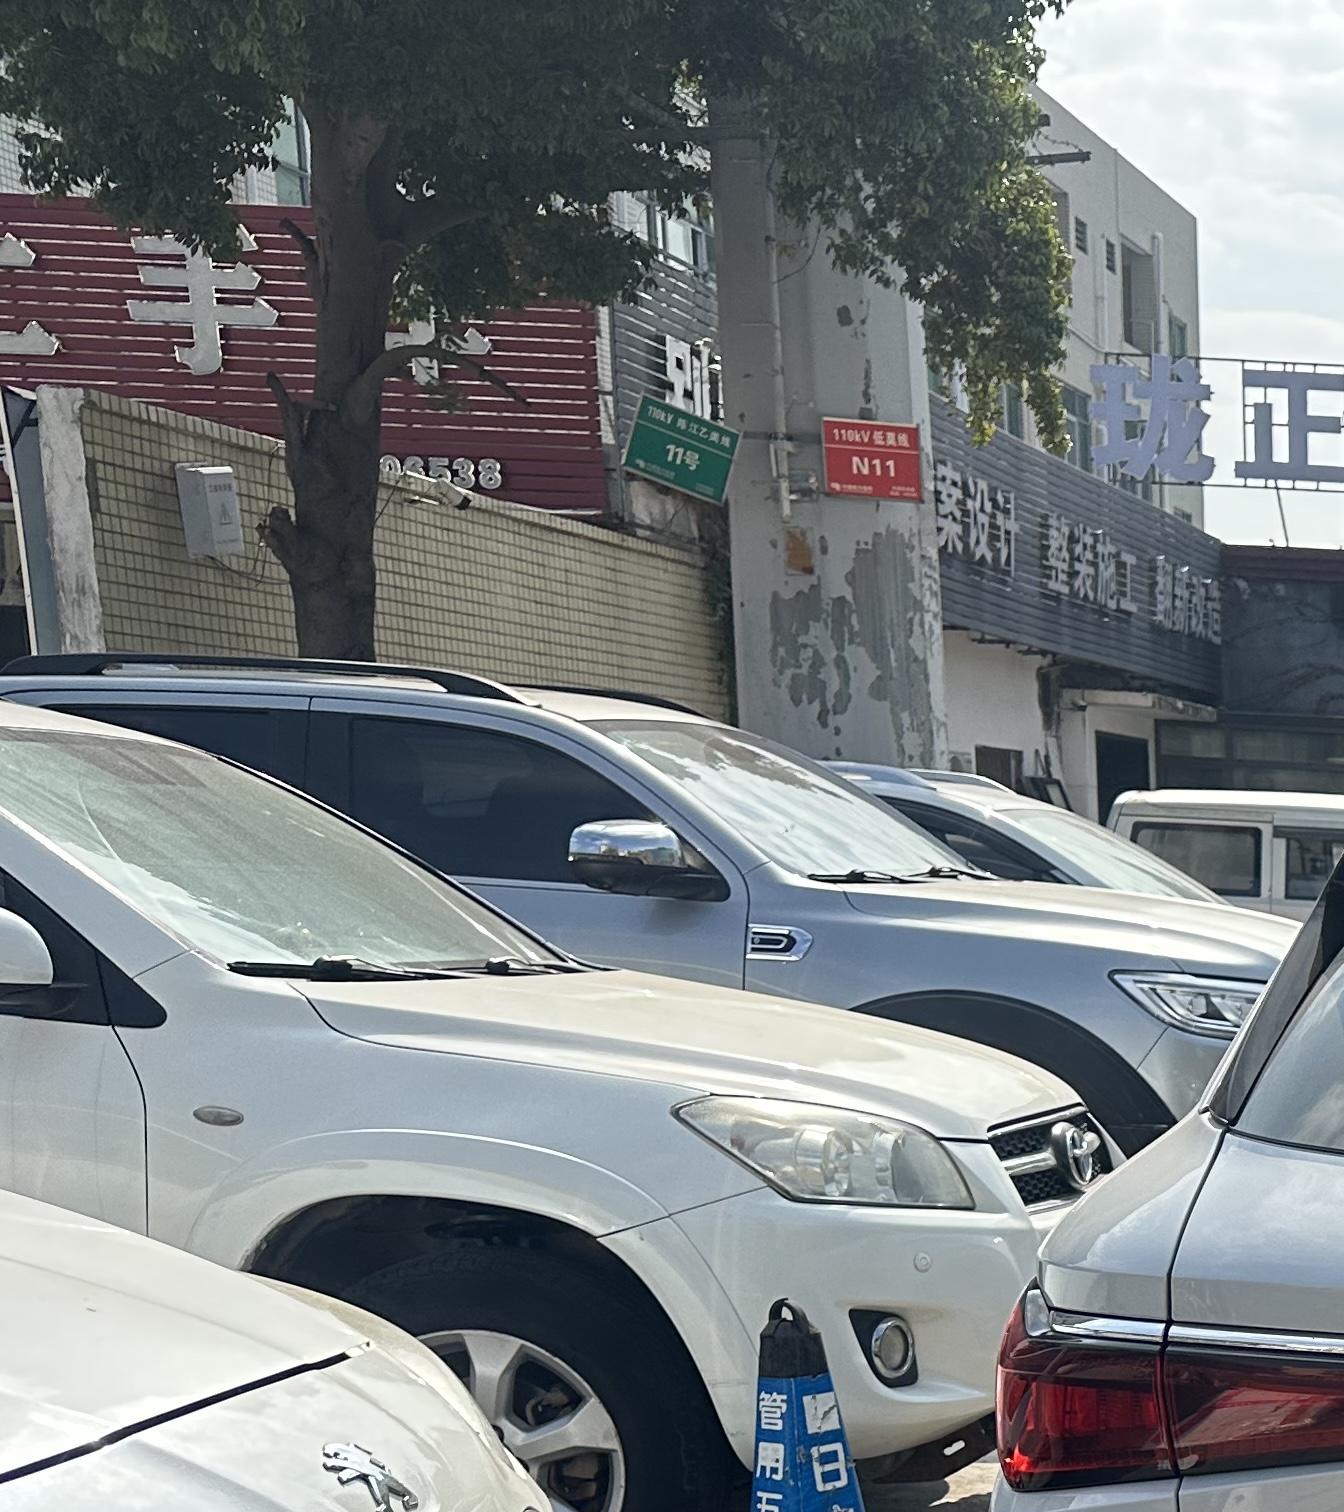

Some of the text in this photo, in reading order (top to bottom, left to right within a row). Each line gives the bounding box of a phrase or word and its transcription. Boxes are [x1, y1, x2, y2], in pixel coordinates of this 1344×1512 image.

[833, 428, 870, 443] 110kV
[666, 444, 700, 471] 11号
[851, 456, 895, 477] N11
